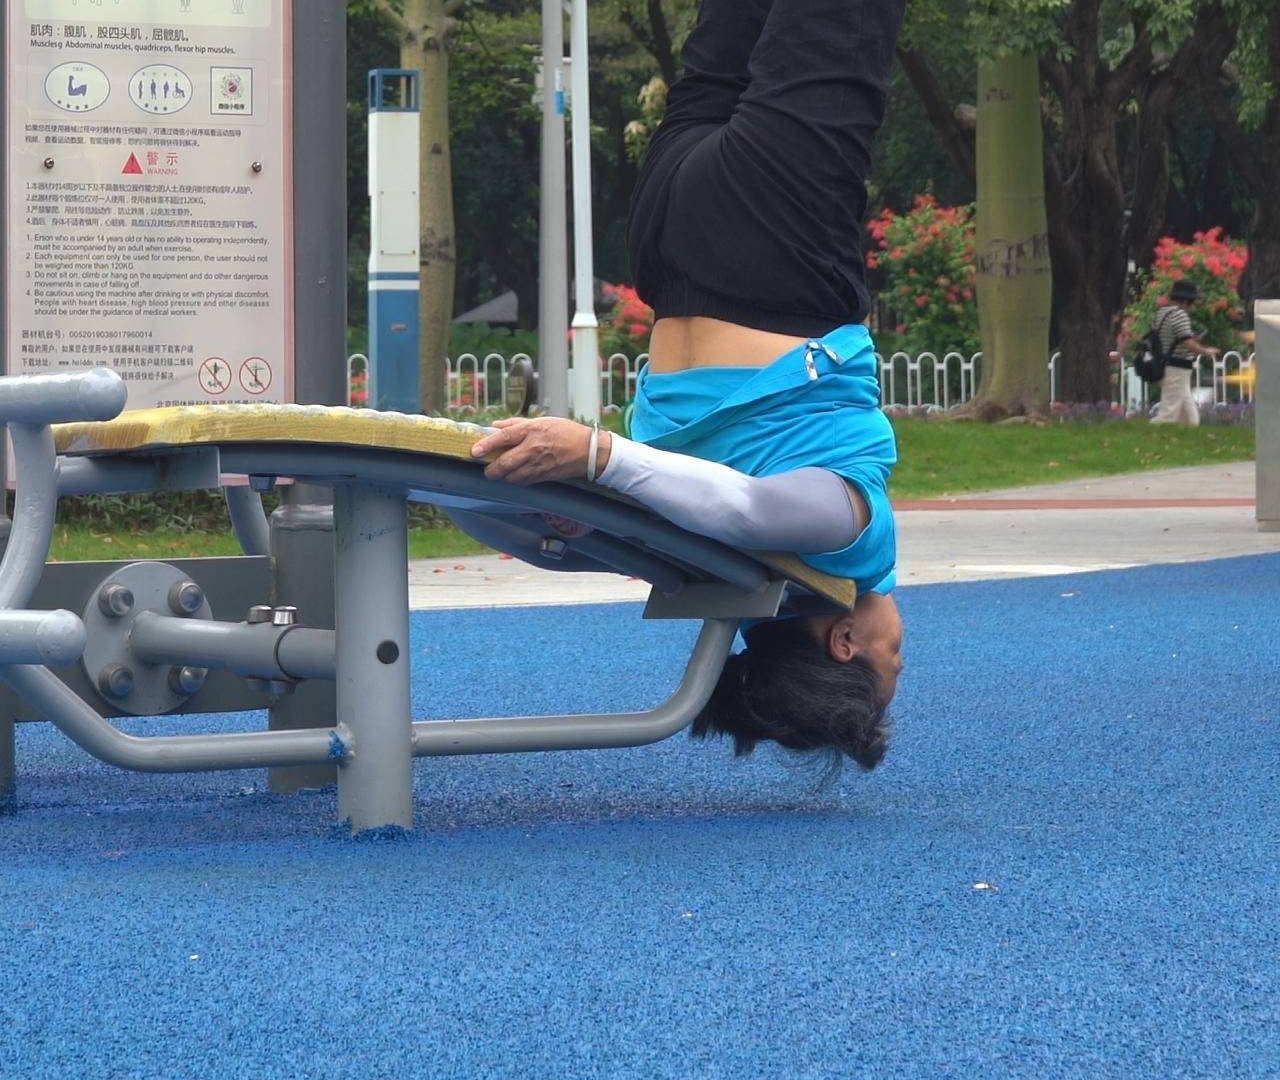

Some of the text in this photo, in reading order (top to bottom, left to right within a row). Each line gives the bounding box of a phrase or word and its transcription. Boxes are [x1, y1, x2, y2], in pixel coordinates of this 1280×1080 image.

[65, 40, 103, 49] Abdominal
[104, 41, 134, 52] muscles,
[174, 44, 193, 53] flexor
[195, 45, 206, 54] hip
[207, 46, 236, 55] muscles.
[54, 253, 90, 261] equipment
[106, 253, 120, 261] only
[44, 262, 73, 271] weighed
[110, 272, 128, 280] hang
[152, 272, 188, 281] equipment
[233, 273, 269, 281] dangerous
[109, 281, 129, 289] falling
[35, 299, 60, 307] People
[131, 299, 147, 308] high
[102, 308, 133, 317] guidance
[143, 308, 169, 316] medical
